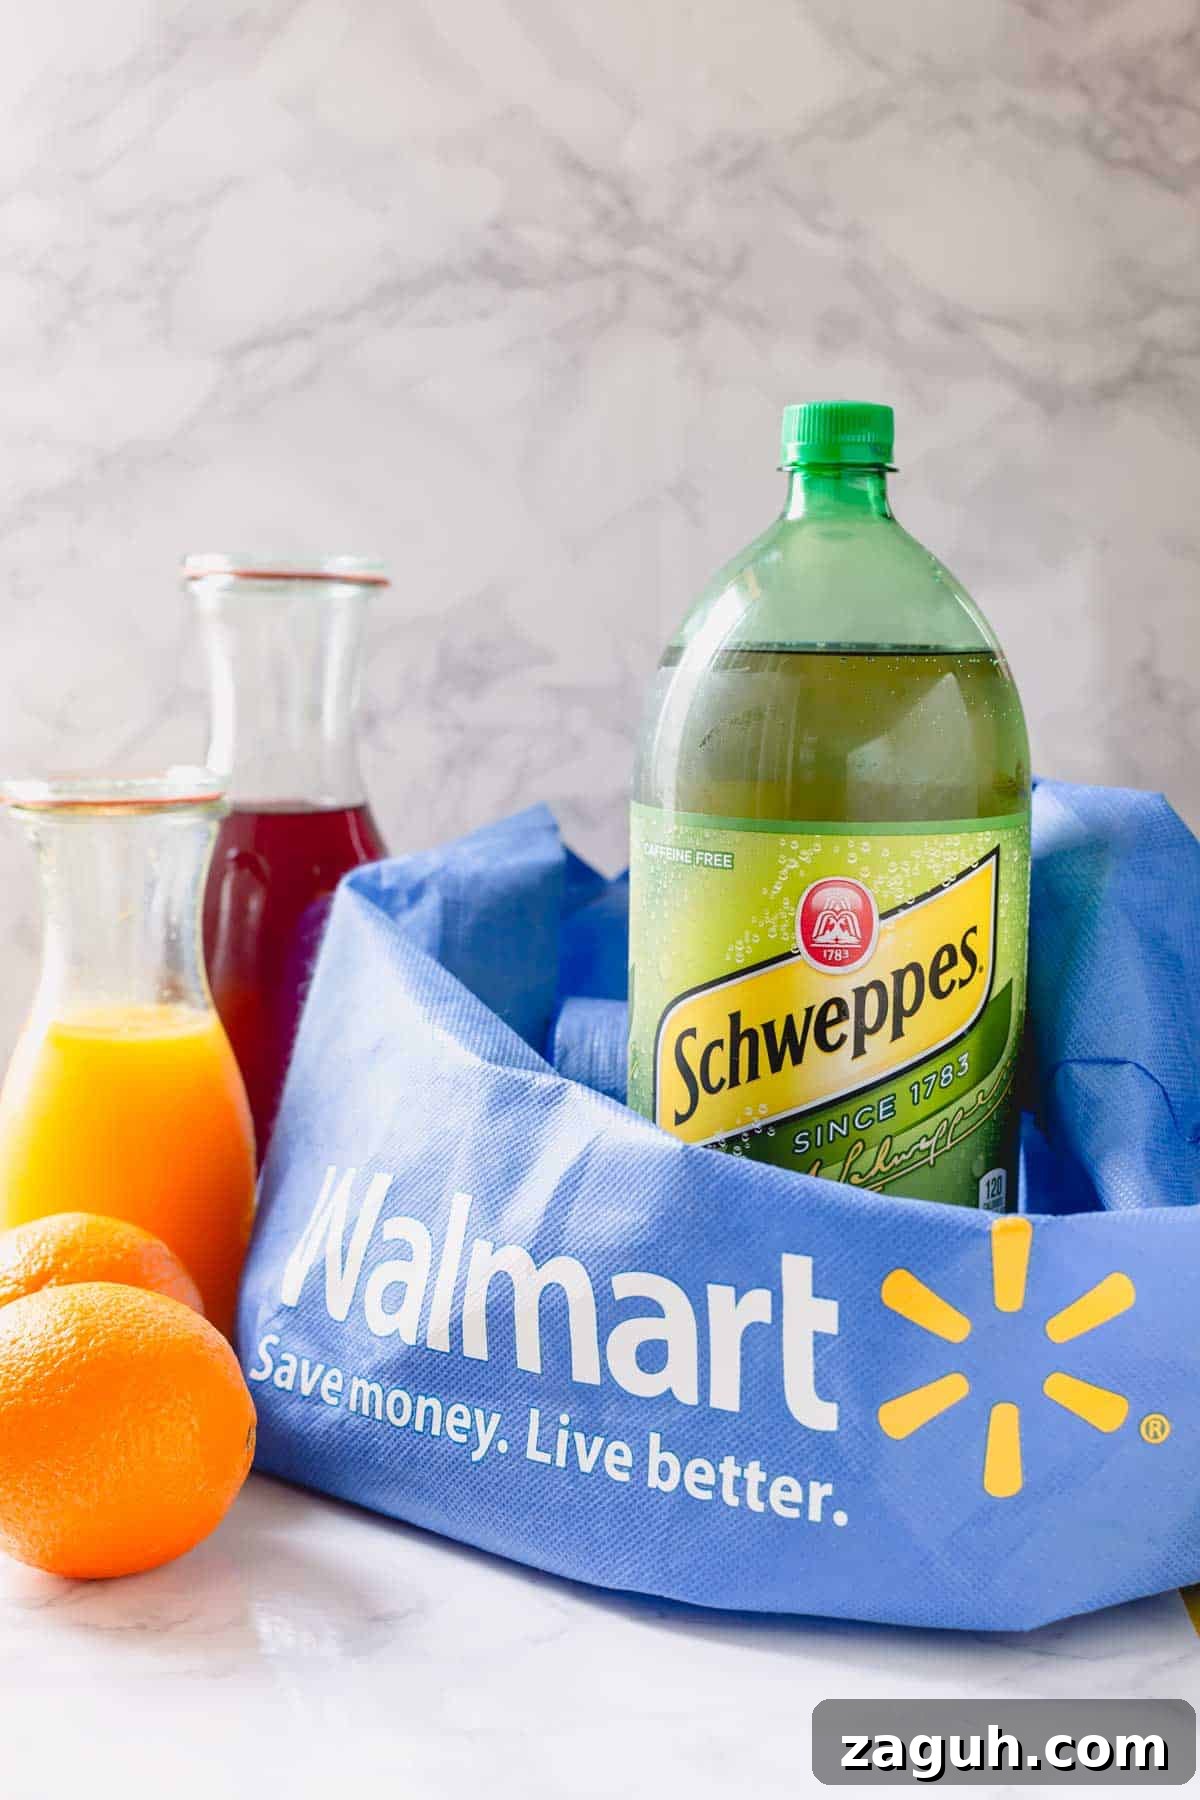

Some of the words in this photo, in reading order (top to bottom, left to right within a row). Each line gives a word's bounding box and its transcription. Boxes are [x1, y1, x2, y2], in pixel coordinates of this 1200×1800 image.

[644, 843, 693, 864] CAFFEINE
[696, 851, 733, 868] FREE
[823, 948, 849, 961] 1783
[794, 1095, 896, 1154] SINCE
[910, 1052, 970, 1104] 1783
[985, 1175, 1003, 1200] 120
[281, 1165, 838, 1431] Walmart
[249, 1334, 345, 1406] Save
[348, 1379, 509, 1463] money.
[526, 1408, 634, 1481] Live
[647, 1432, 849, 1527] better.
